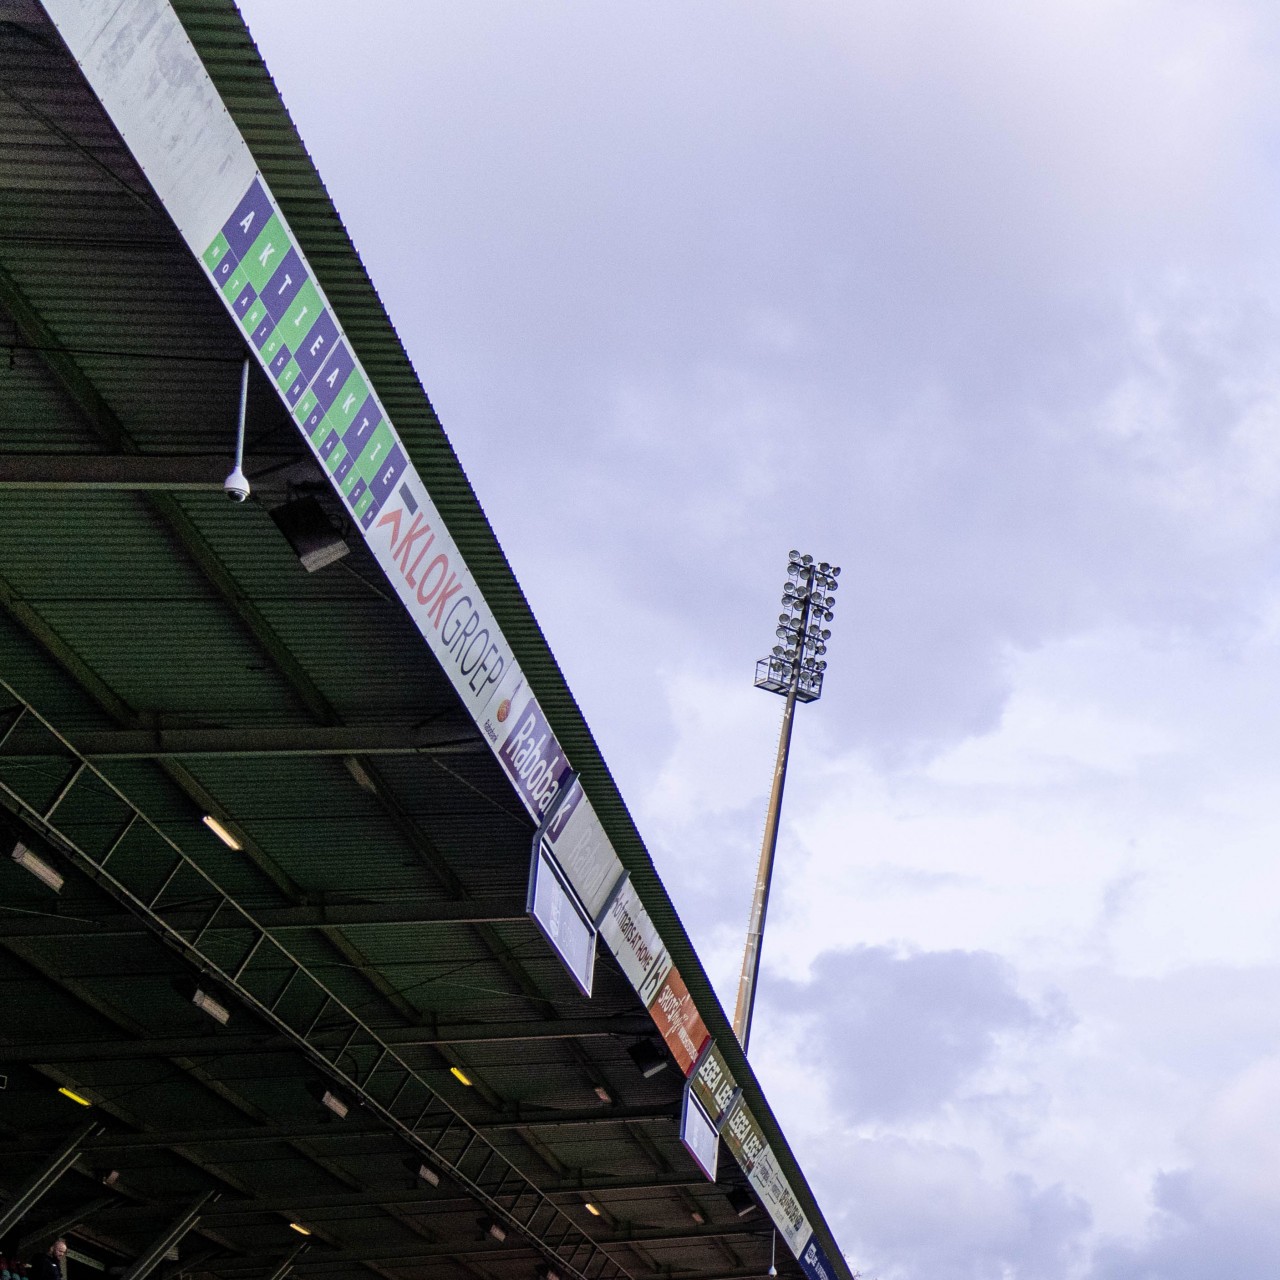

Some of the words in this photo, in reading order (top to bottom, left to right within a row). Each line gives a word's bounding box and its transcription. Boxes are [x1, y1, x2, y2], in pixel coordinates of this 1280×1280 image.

[212, 246, 300, 395] NOTARISSEN
[240, 211, 324, 356] AKTIE
[326, 368, 395, 486] AKTIE
[392, 511, 505, 697] KLOKGROEP
[506, 712, 575, 832] Rabobak
